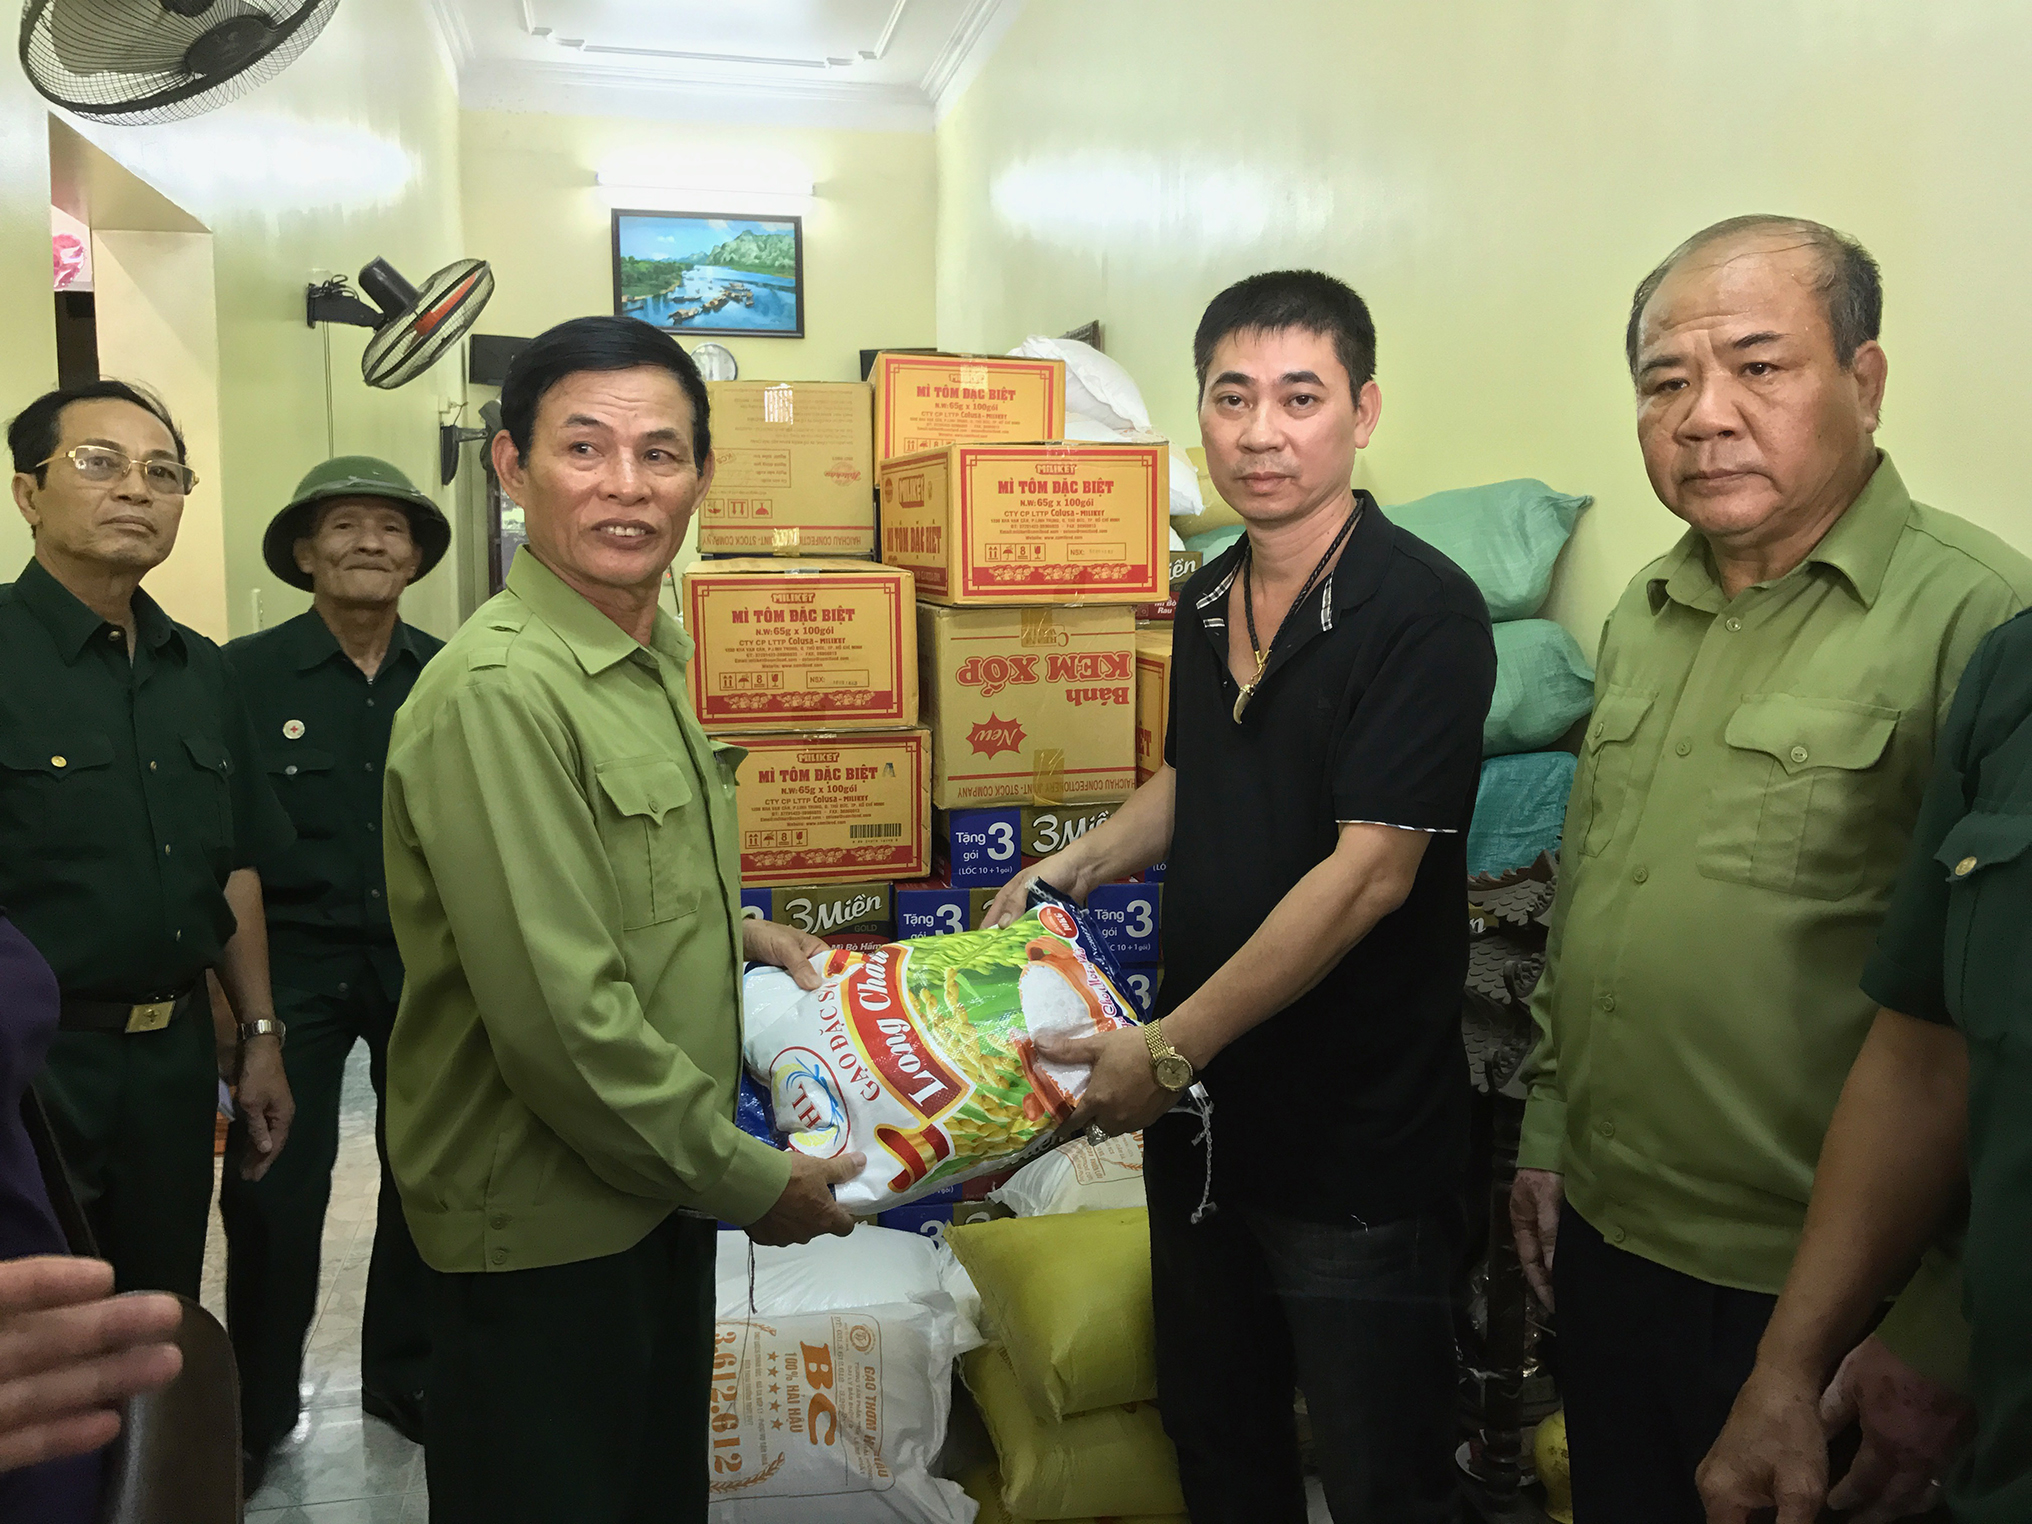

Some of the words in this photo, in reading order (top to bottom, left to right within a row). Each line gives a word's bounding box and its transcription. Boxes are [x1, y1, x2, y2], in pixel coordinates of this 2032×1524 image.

[917, 383, 930, 398] MÌ
[934, 384, 959, 398] TÔM
[989, 387, 1016, 403] BIỆT
[1036, 464, 1077, 475] MILIKET
[998, 478, 1014, 494] MÌ
[1018, 478, 1048, 494] TÔM
[1052, 478, 1078, 497] ĐẶC
[1082, 478, 1114, 497] BIỆT
[1065, 498, 1094, 508] 100gói
[702, 535, 733, 545] COMPANY
[734, 536, 756, 545] STOCK
[833, 536, 861, 545] HAICHAU
[771, 592, 815, 603] MILIKET
[732, 607, 749, 624] MÌ
[753, 606, 785, 623] TÔM
[789, 606, 817, 626] ĐẶC
[822, 605, 855, 625] BIỆT
[802, 626, 834, 636] 100gói
[788, 637, 814, 645] Colusa
[955, 654, 1040, 697] XỐP
[1045, 651, 1132, 683] KEM
[1065, 687, 1130, 707] Bánh
[974, 728, 1017, 746] New
[797, 752, 840, 763] MILIKET
[758, 767, 775, 783] MÌ
[779, 766, 810, 783] TÔM
[814, 765, 841, 784] ĐẶC
[846, 764, 878, 783] BIỆT
[827, 785, 857, 794] 100gói
[957, 786, 992, 798] COMPANY
[994, 784, 1019, 796] STOCK
[1104, 778, 1135, 790] HAICHAU
[812, 796, 837, 804] Colusa
[956, 831, 986, 846] Tặng
[987, 822, 1015, 861] 3
[963, 851, 979, 862] gói
[903, 913, 935, 927] Tặng
[935, 904, 964, 936] 3
[1094, 909, 1125, 923] Tặng
[1126, 900, 1153, 938] 3
[1102, 927, 1118, 938] gói
[846, 943, 859, 951] Bò
[819, 1005, 850, 1053] ĐẶC
[876, 1018, 949, 1108] Long
[839, 1054, 881, 1102] GẠO
[792, 1083, 822, 1129] HL
[784, 1352, 798, 1382] 100%
[862, 1366, 875, 1391] GẠO
[709, 1331, 743, 1475] 3.612.612
[786, 1385, 804, 1404] HẢI
[800, 1341, 838, 1446] BC
[784, 1408, 804, 1433] HẬU
[865, 1395, 877, 1431] THƠM
